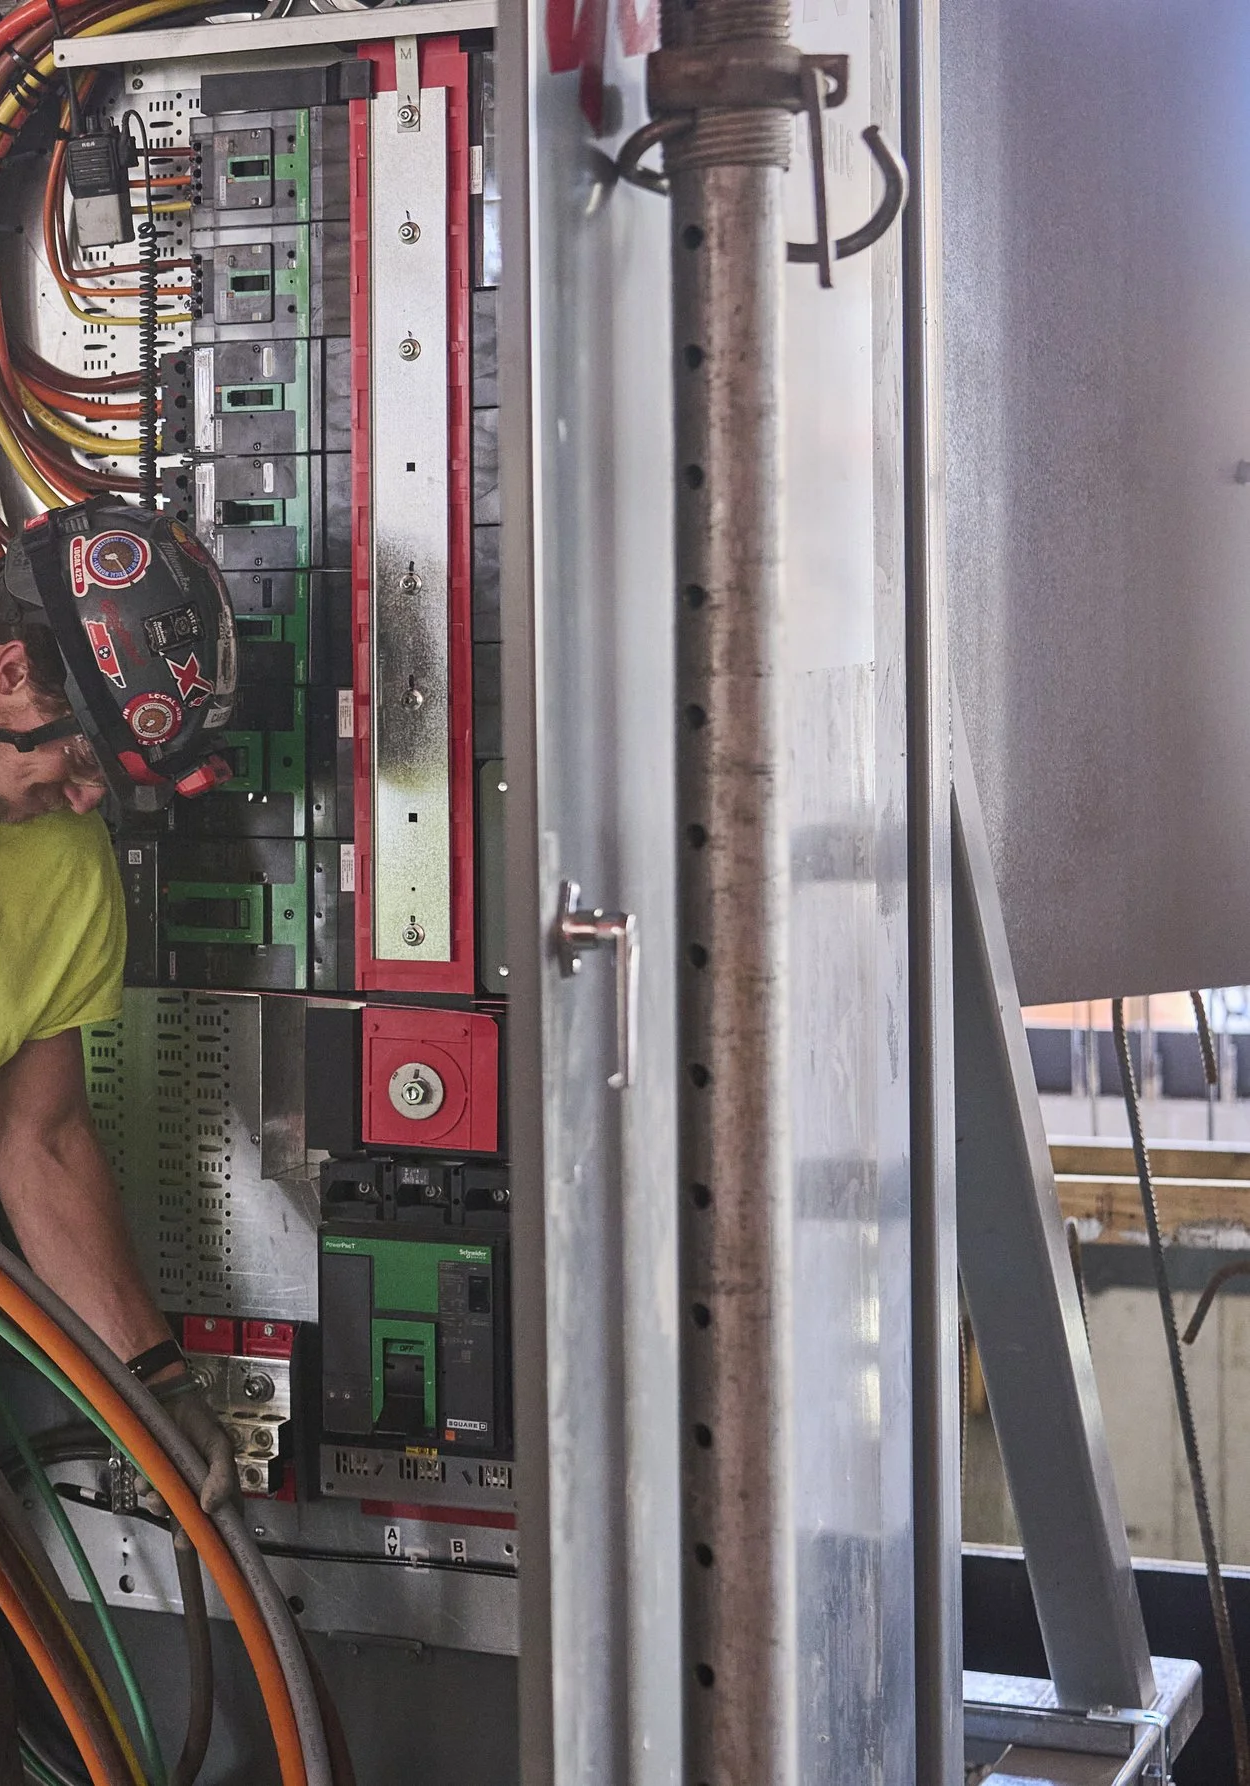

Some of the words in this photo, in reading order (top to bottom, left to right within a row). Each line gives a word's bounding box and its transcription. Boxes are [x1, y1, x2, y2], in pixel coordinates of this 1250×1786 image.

[400, 48, 412, 60] M
[74, 545, 82, 567] LOCAL
[148, 693, 175, 706] LOCAL
[459, 1248, 487, 1258] Schneider
[448, 1420, 478, 1429] SQUARE
[478, 1421, 488, 1431] D
[387, 1528, 398, 1540] A
[453, 1540, 463, 1553] B
